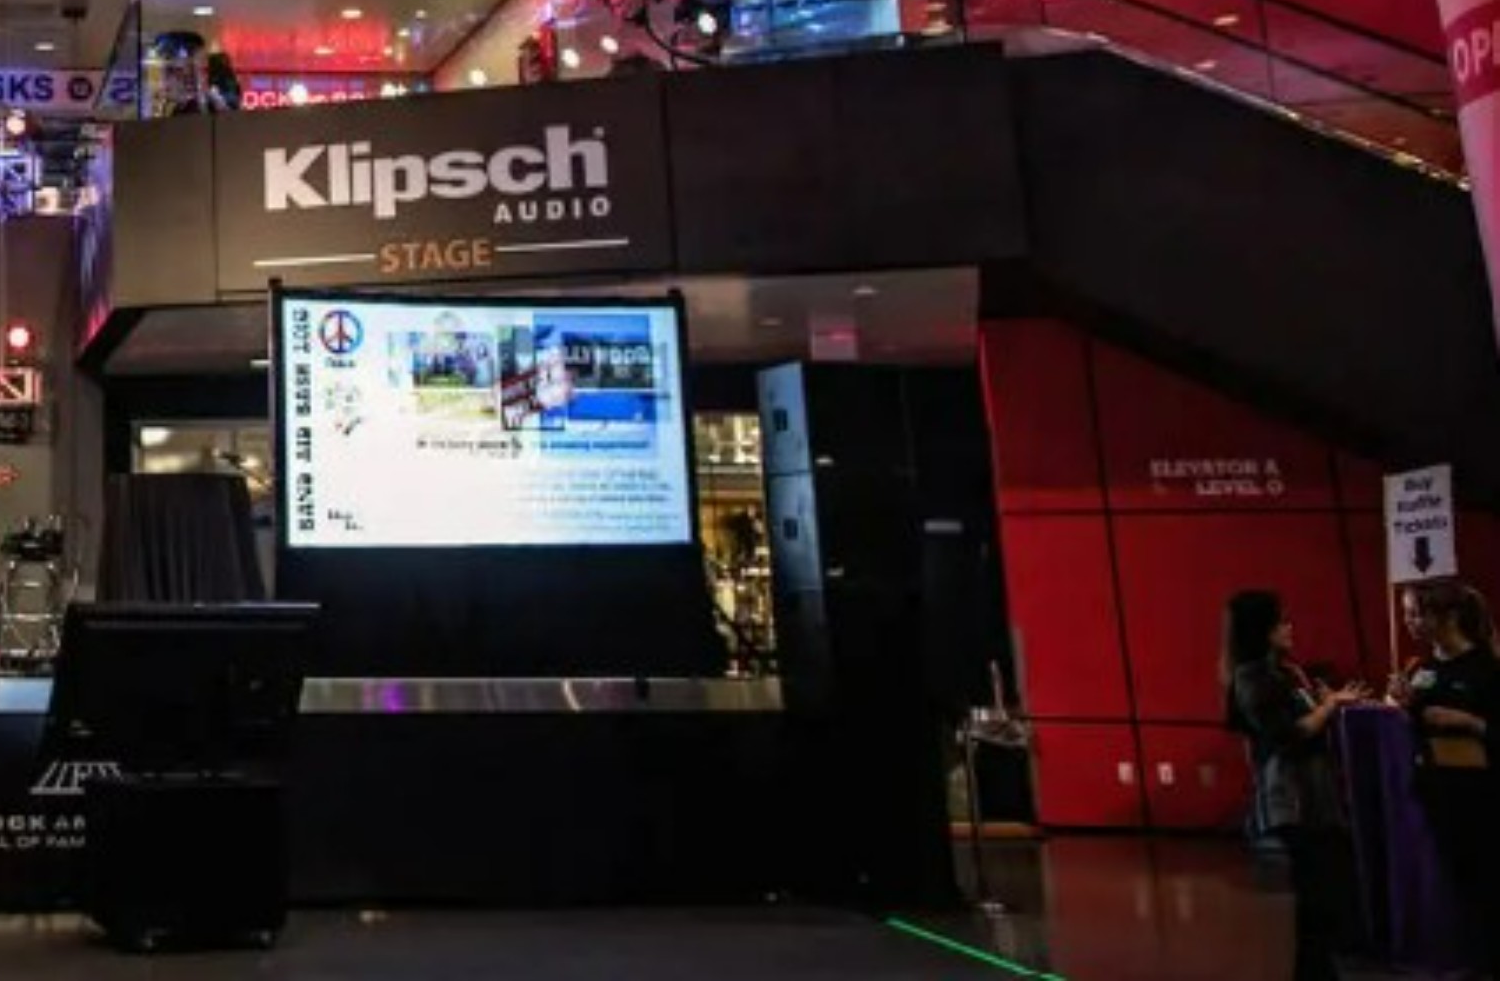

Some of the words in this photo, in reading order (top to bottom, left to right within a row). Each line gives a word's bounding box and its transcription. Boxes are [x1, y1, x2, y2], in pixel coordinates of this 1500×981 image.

[263, 124, 609, 219] Klipsch
[493, 196, 611, 224] AUDIO
[379, 238, 493, 274] STAGE
[1151, 458, 1258, 478] ELEVATOR
[1196, 478, 1264, 497] LEVEL
[45, 836, 86, 848] FAM
